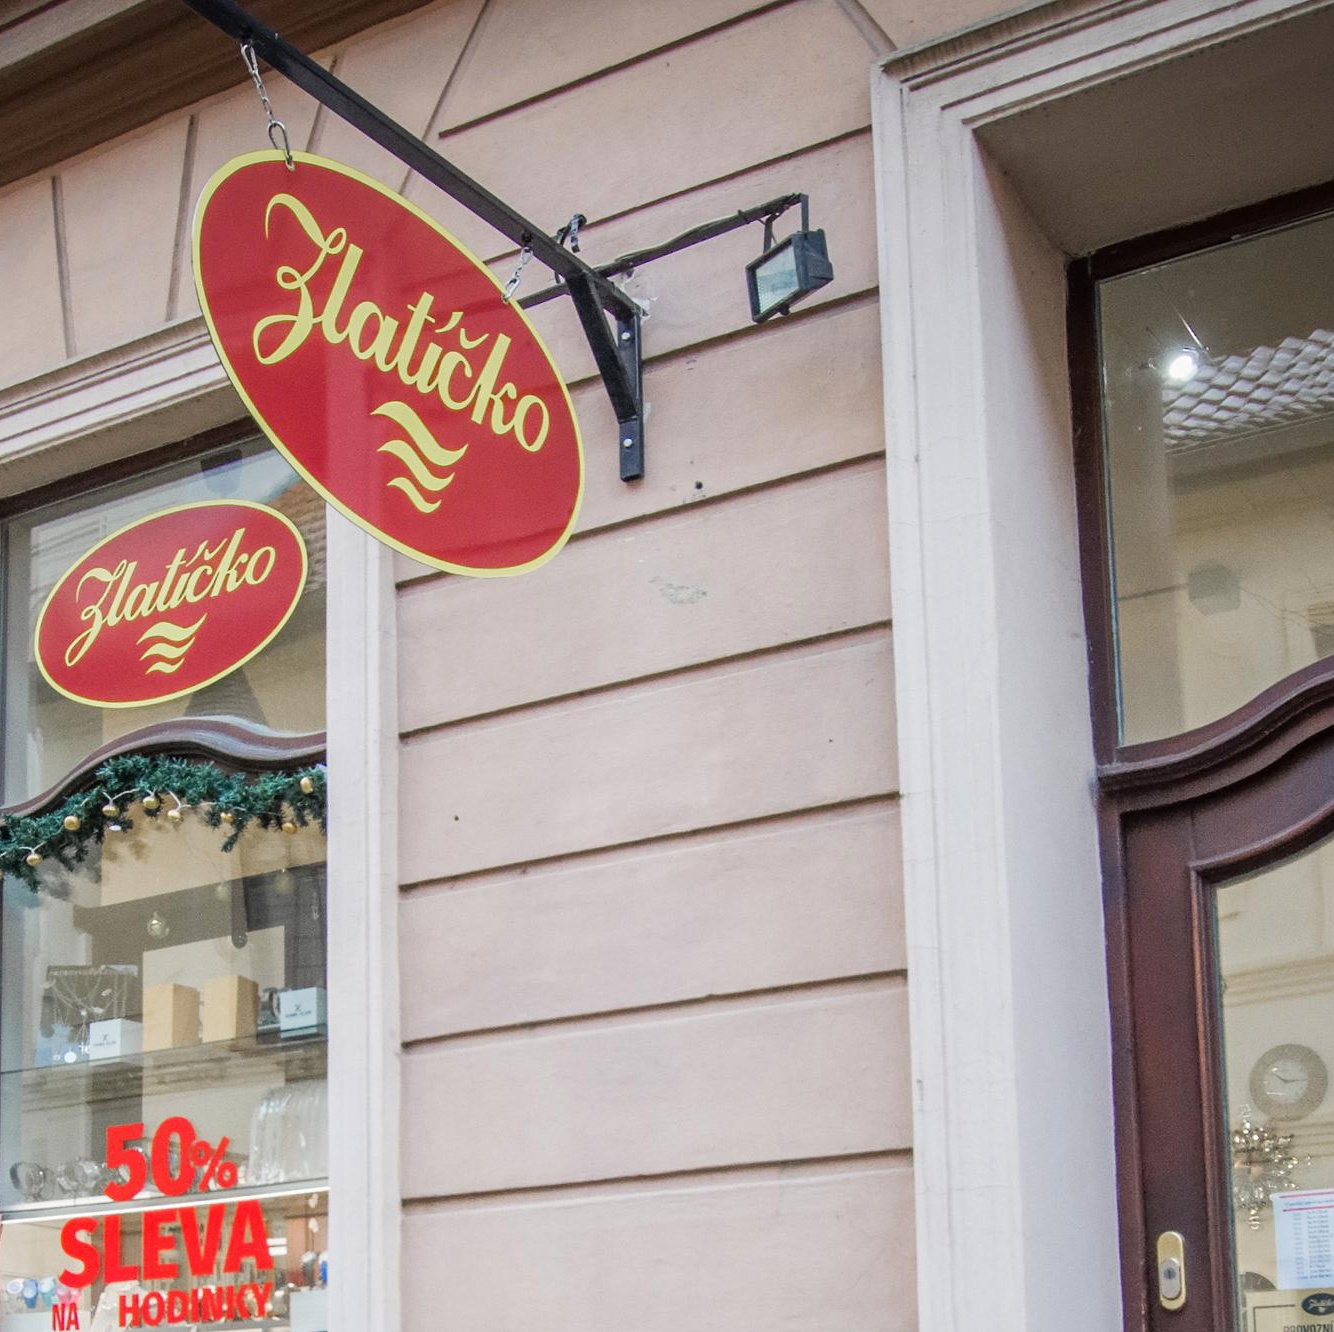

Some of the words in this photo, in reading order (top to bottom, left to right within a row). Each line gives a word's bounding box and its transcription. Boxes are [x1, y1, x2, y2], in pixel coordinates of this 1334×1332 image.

[253, 194, 549, 452] Zlatíčko
[66, 529, 277, 667] Zlatíčko
[104, 1116, 238, 1202] 50%
[58, 1199, 274, 1289] SLEVA
[51, 1302, 81, 1332] NA
[118, 1282, 273, 1327] HODINKY
